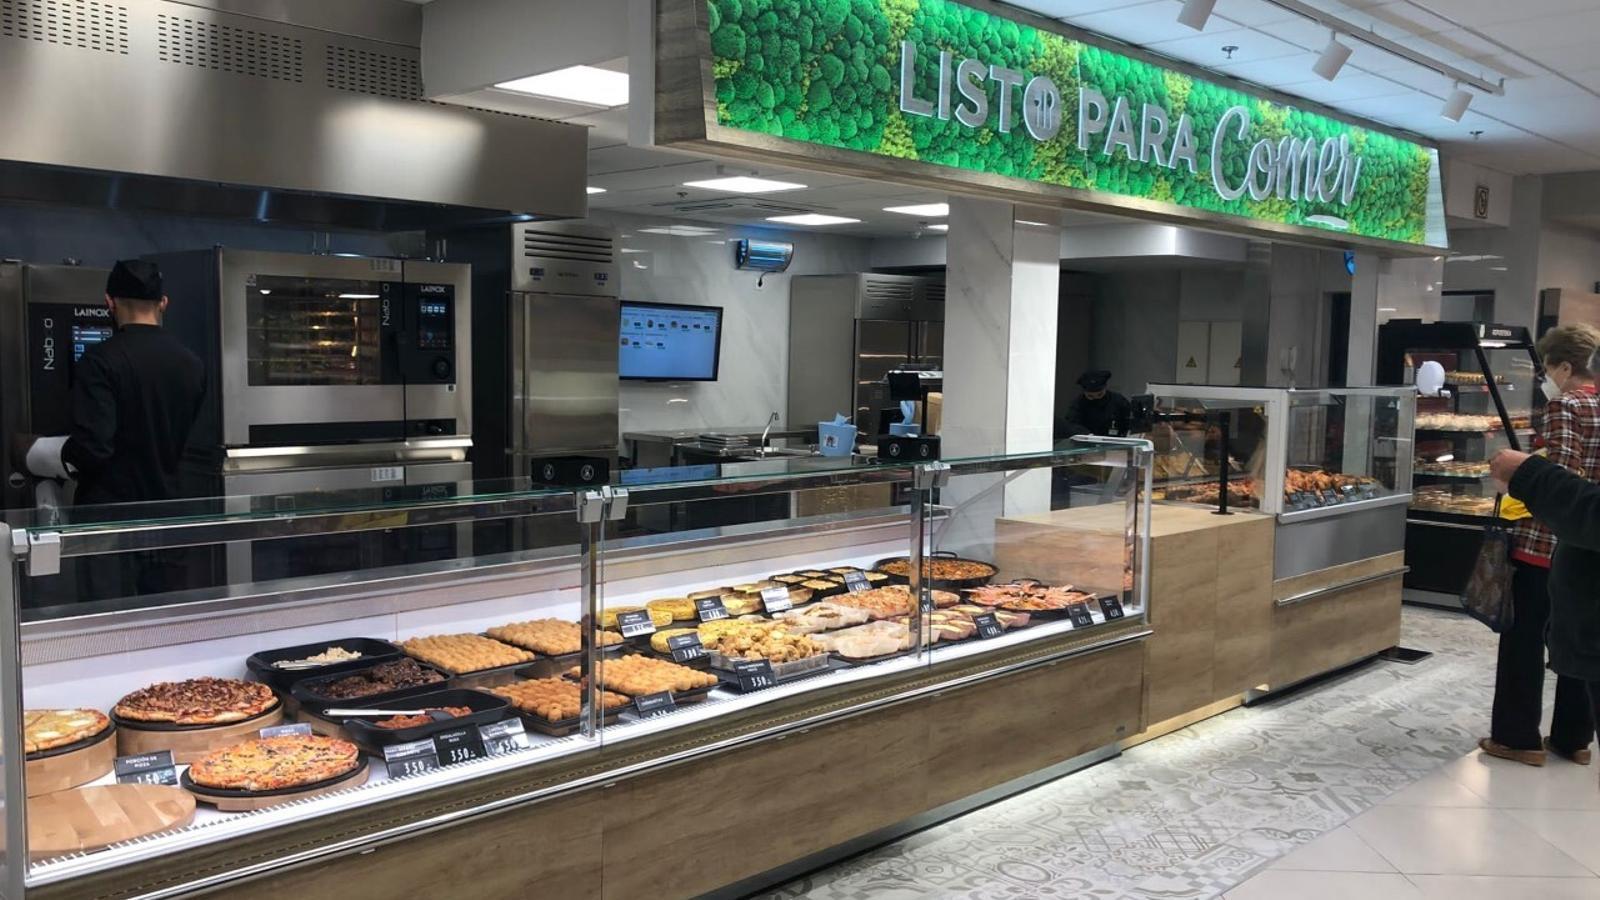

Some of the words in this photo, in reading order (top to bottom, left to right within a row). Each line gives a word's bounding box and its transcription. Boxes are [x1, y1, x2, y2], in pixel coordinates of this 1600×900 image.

[900, 40, 1062, 142] LISTO
[1078, 86, 1198, 174] PARA
[1211, 105, 1362, 204] Comer
[420, 285, 446, 294] LAINOX
[74, 308, 110, 318] LAINOX
